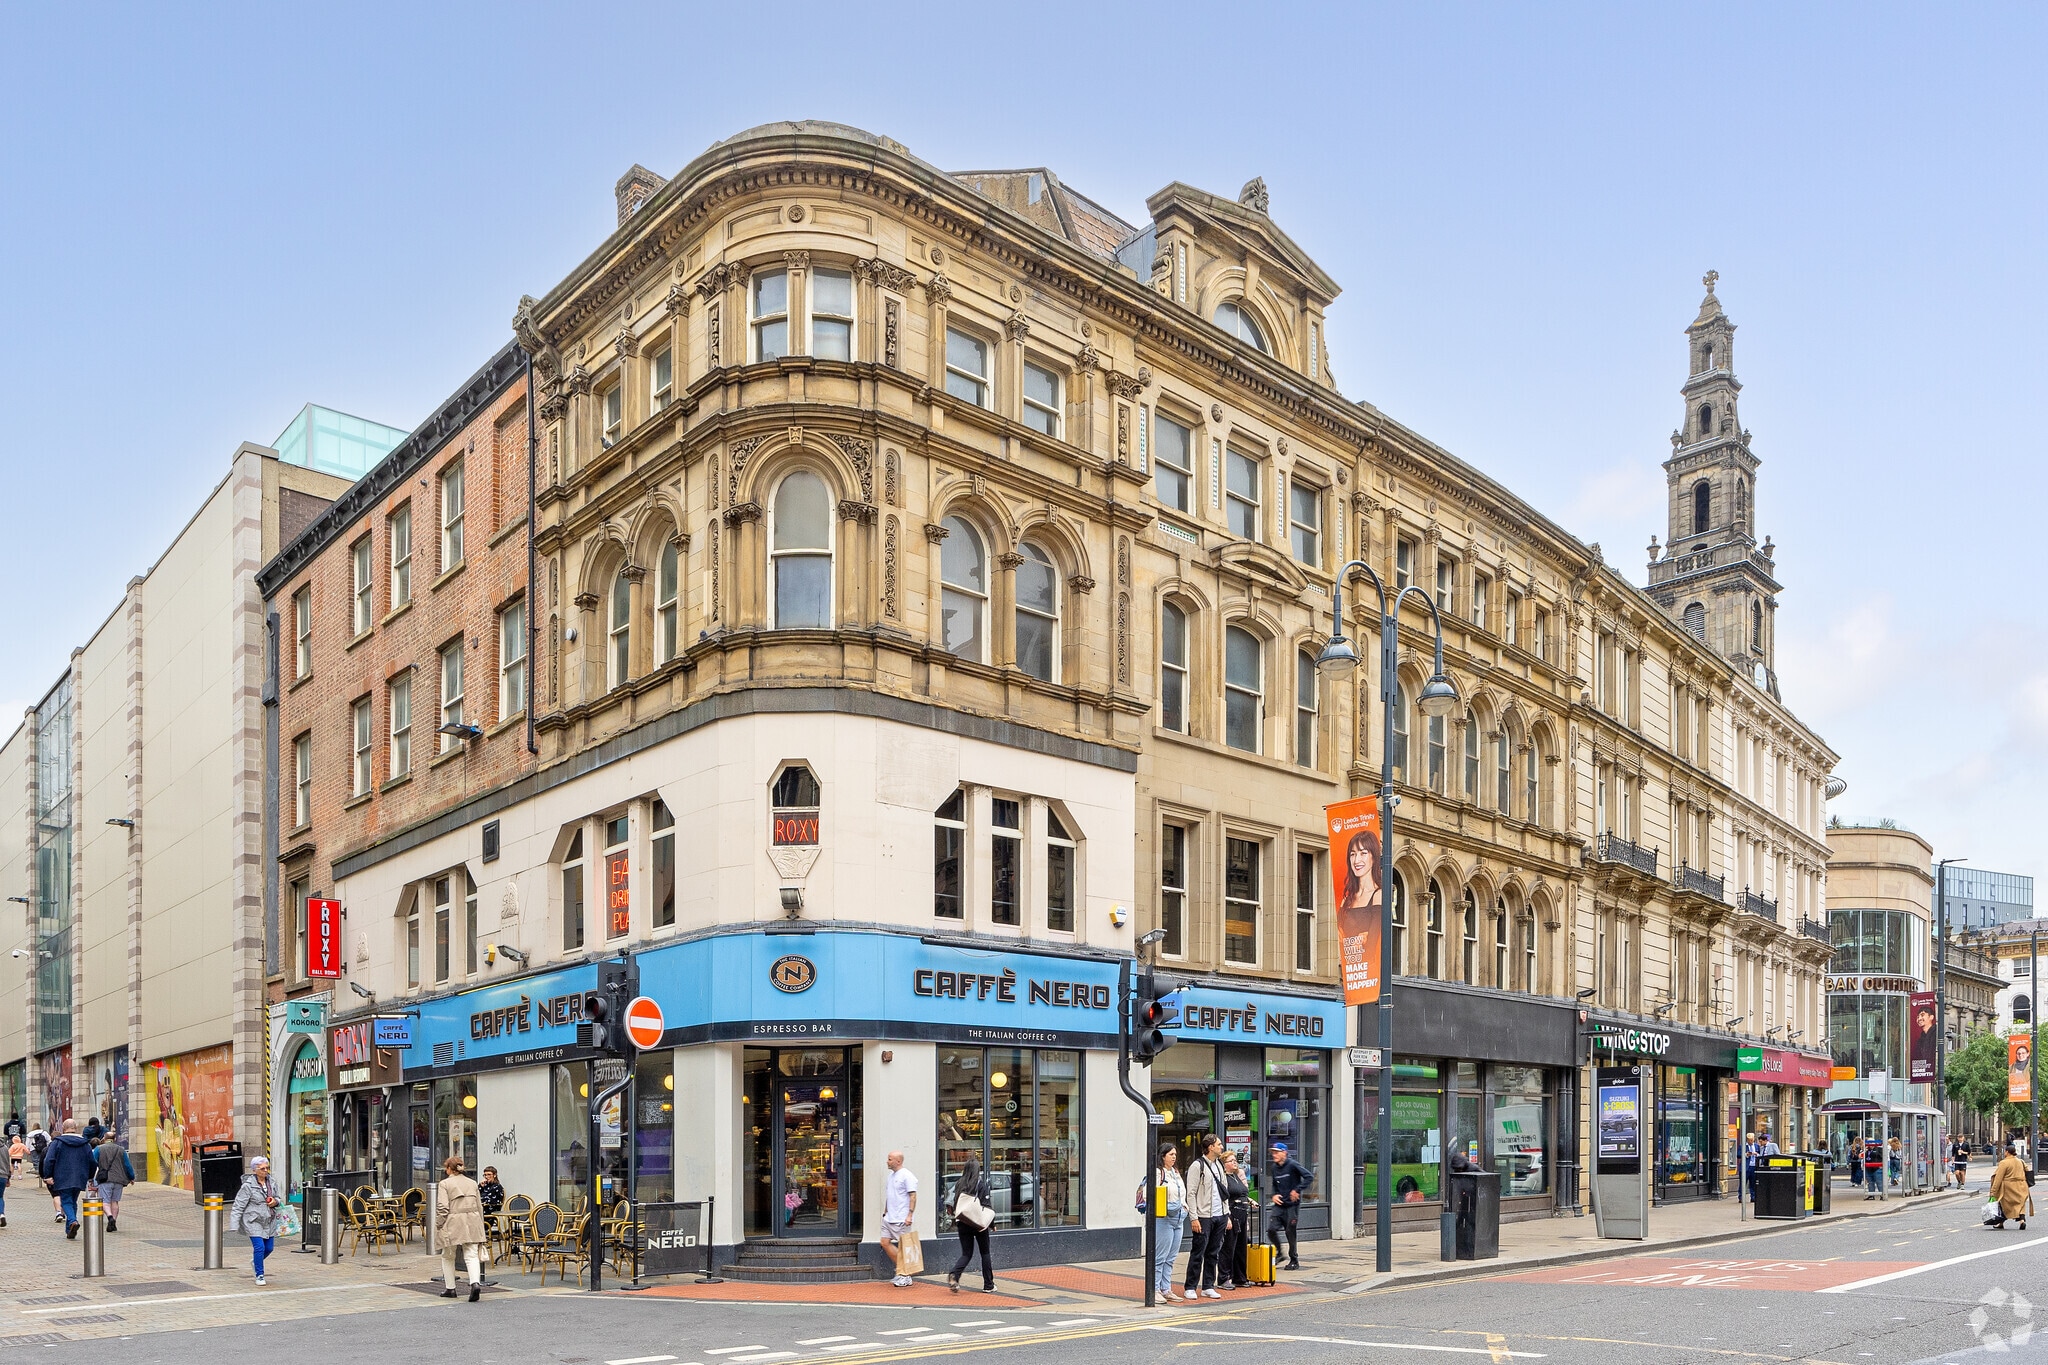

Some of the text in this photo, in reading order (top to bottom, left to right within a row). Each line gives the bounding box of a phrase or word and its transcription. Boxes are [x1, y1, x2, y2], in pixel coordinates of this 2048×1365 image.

[1343, 813, 1375, 825] Leeds Trinity
[1343, 821, 1369, 830] University
[775, 818, 819, 843] ROXY
[611, 859, 630, 885] EA
[321, 907, 330, 968] ROXY
[1343, 935, 1364, 946] HOW
[1344, 944, 1366, 956] WILL
[1345, 953, 1362, 964] YOU
[783, 965, 803, 981] N
[1345, 962, 1368, 973] MAKE
[1346, 971, 1368, 982] MORE
[914, 966, 1111, 1009] CAFFÈ NERO
[1346, 978, 1378, 991] HAPPEN?
[1825, 977, 1858, 992] BAN
[470, 994, 531, 1040] CAFFÈ
[1184, 1002, 1324, 1037] CAFFÈ NERO
[753, 1023, 833, 1034] ESPRESSO BAR
[968, 1029, 982, 1038] THE
[985, 1030, 1014, 1039] ITALIAN
[1016, 1031, 1044, 1041] COFFEE
[378, 1032, 408, 1040] NERO
[505, 1056, 514, 1065] THE
[515, 1053, 534, 1062] ITALIAN
[535, 1050, 555, 1060] COFFEE
[295, 1058, 322, 1079] KOKORO
[1770, 1057, 1783, 1073] Local
[1603, 1101, 1635, 1111] S-CROSS
[174, 1160, 192, 1175] DISCOV
[308, 1214, 322, 1225] NER
[661, 1228, 684, 1237] CAFFÈ
[647, 1235, 696, 1250] NERO
